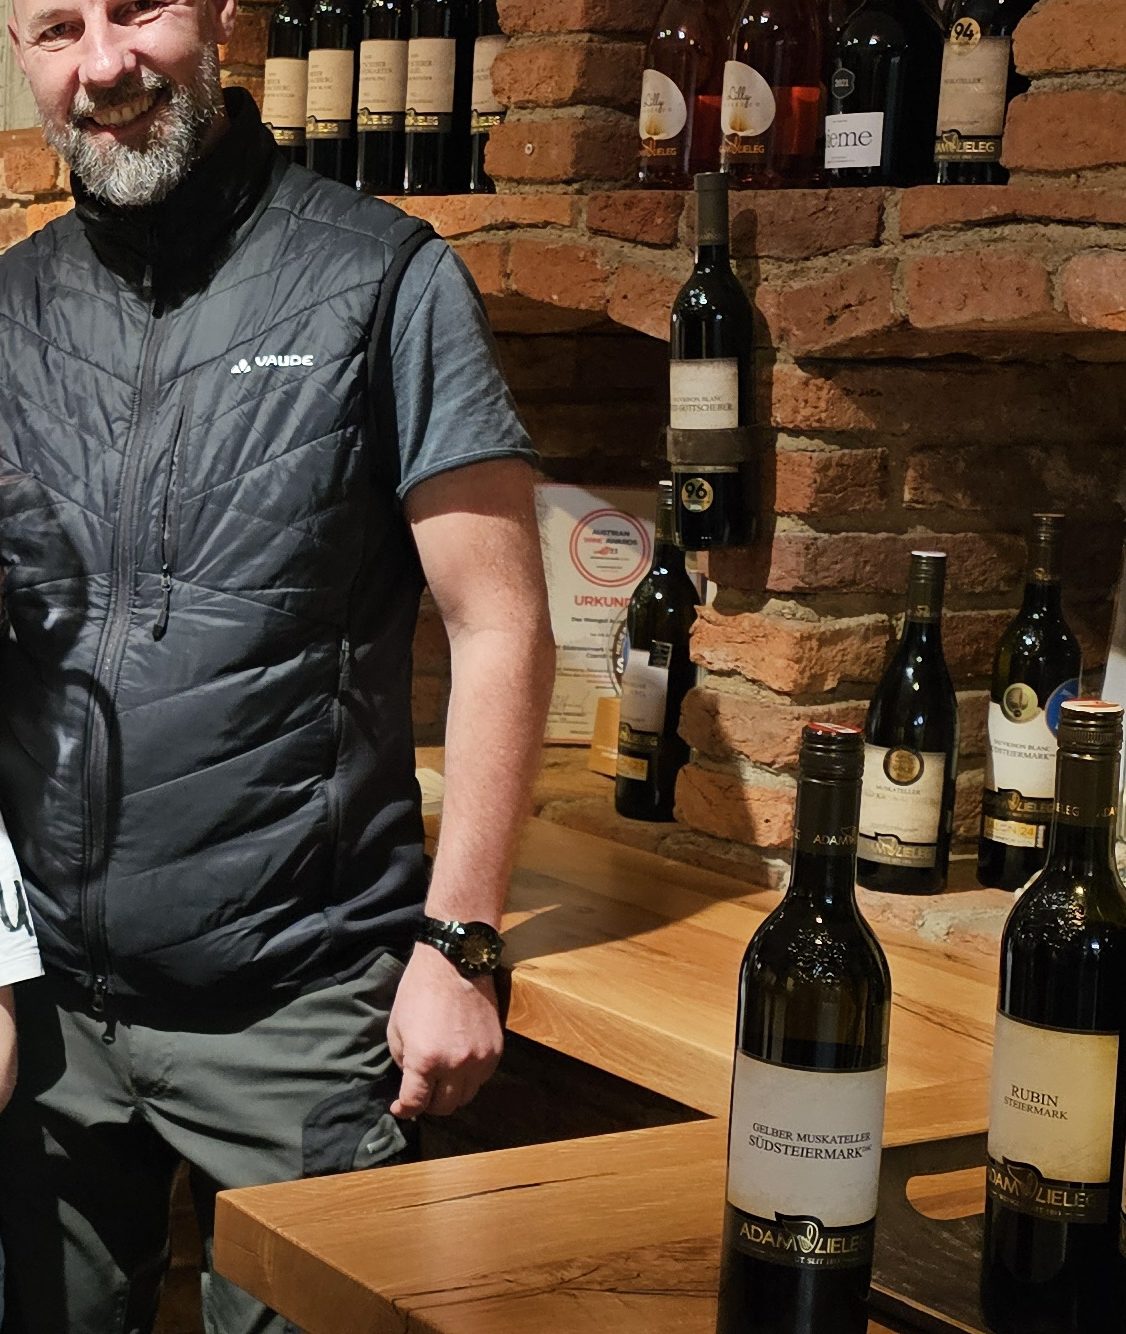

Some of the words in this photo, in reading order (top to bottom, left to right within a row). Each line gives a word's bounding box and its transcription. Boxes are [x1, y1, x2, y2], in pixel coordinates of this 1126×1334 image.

[953, 21, 975, 42] 94
[254, 354, 315, 367] VAUDE
[684, 481, 708, 500] 96
[1011, 1083, 1059, 1108] RUBIN
[1004, 1096, 1069, 1121] STEIERMARK
[752, 1121, 794, 1142] GELBER
[796, 1131, 872, 1145] MUSKATELLER
[739, 1222, 798, 1252] ADAM
